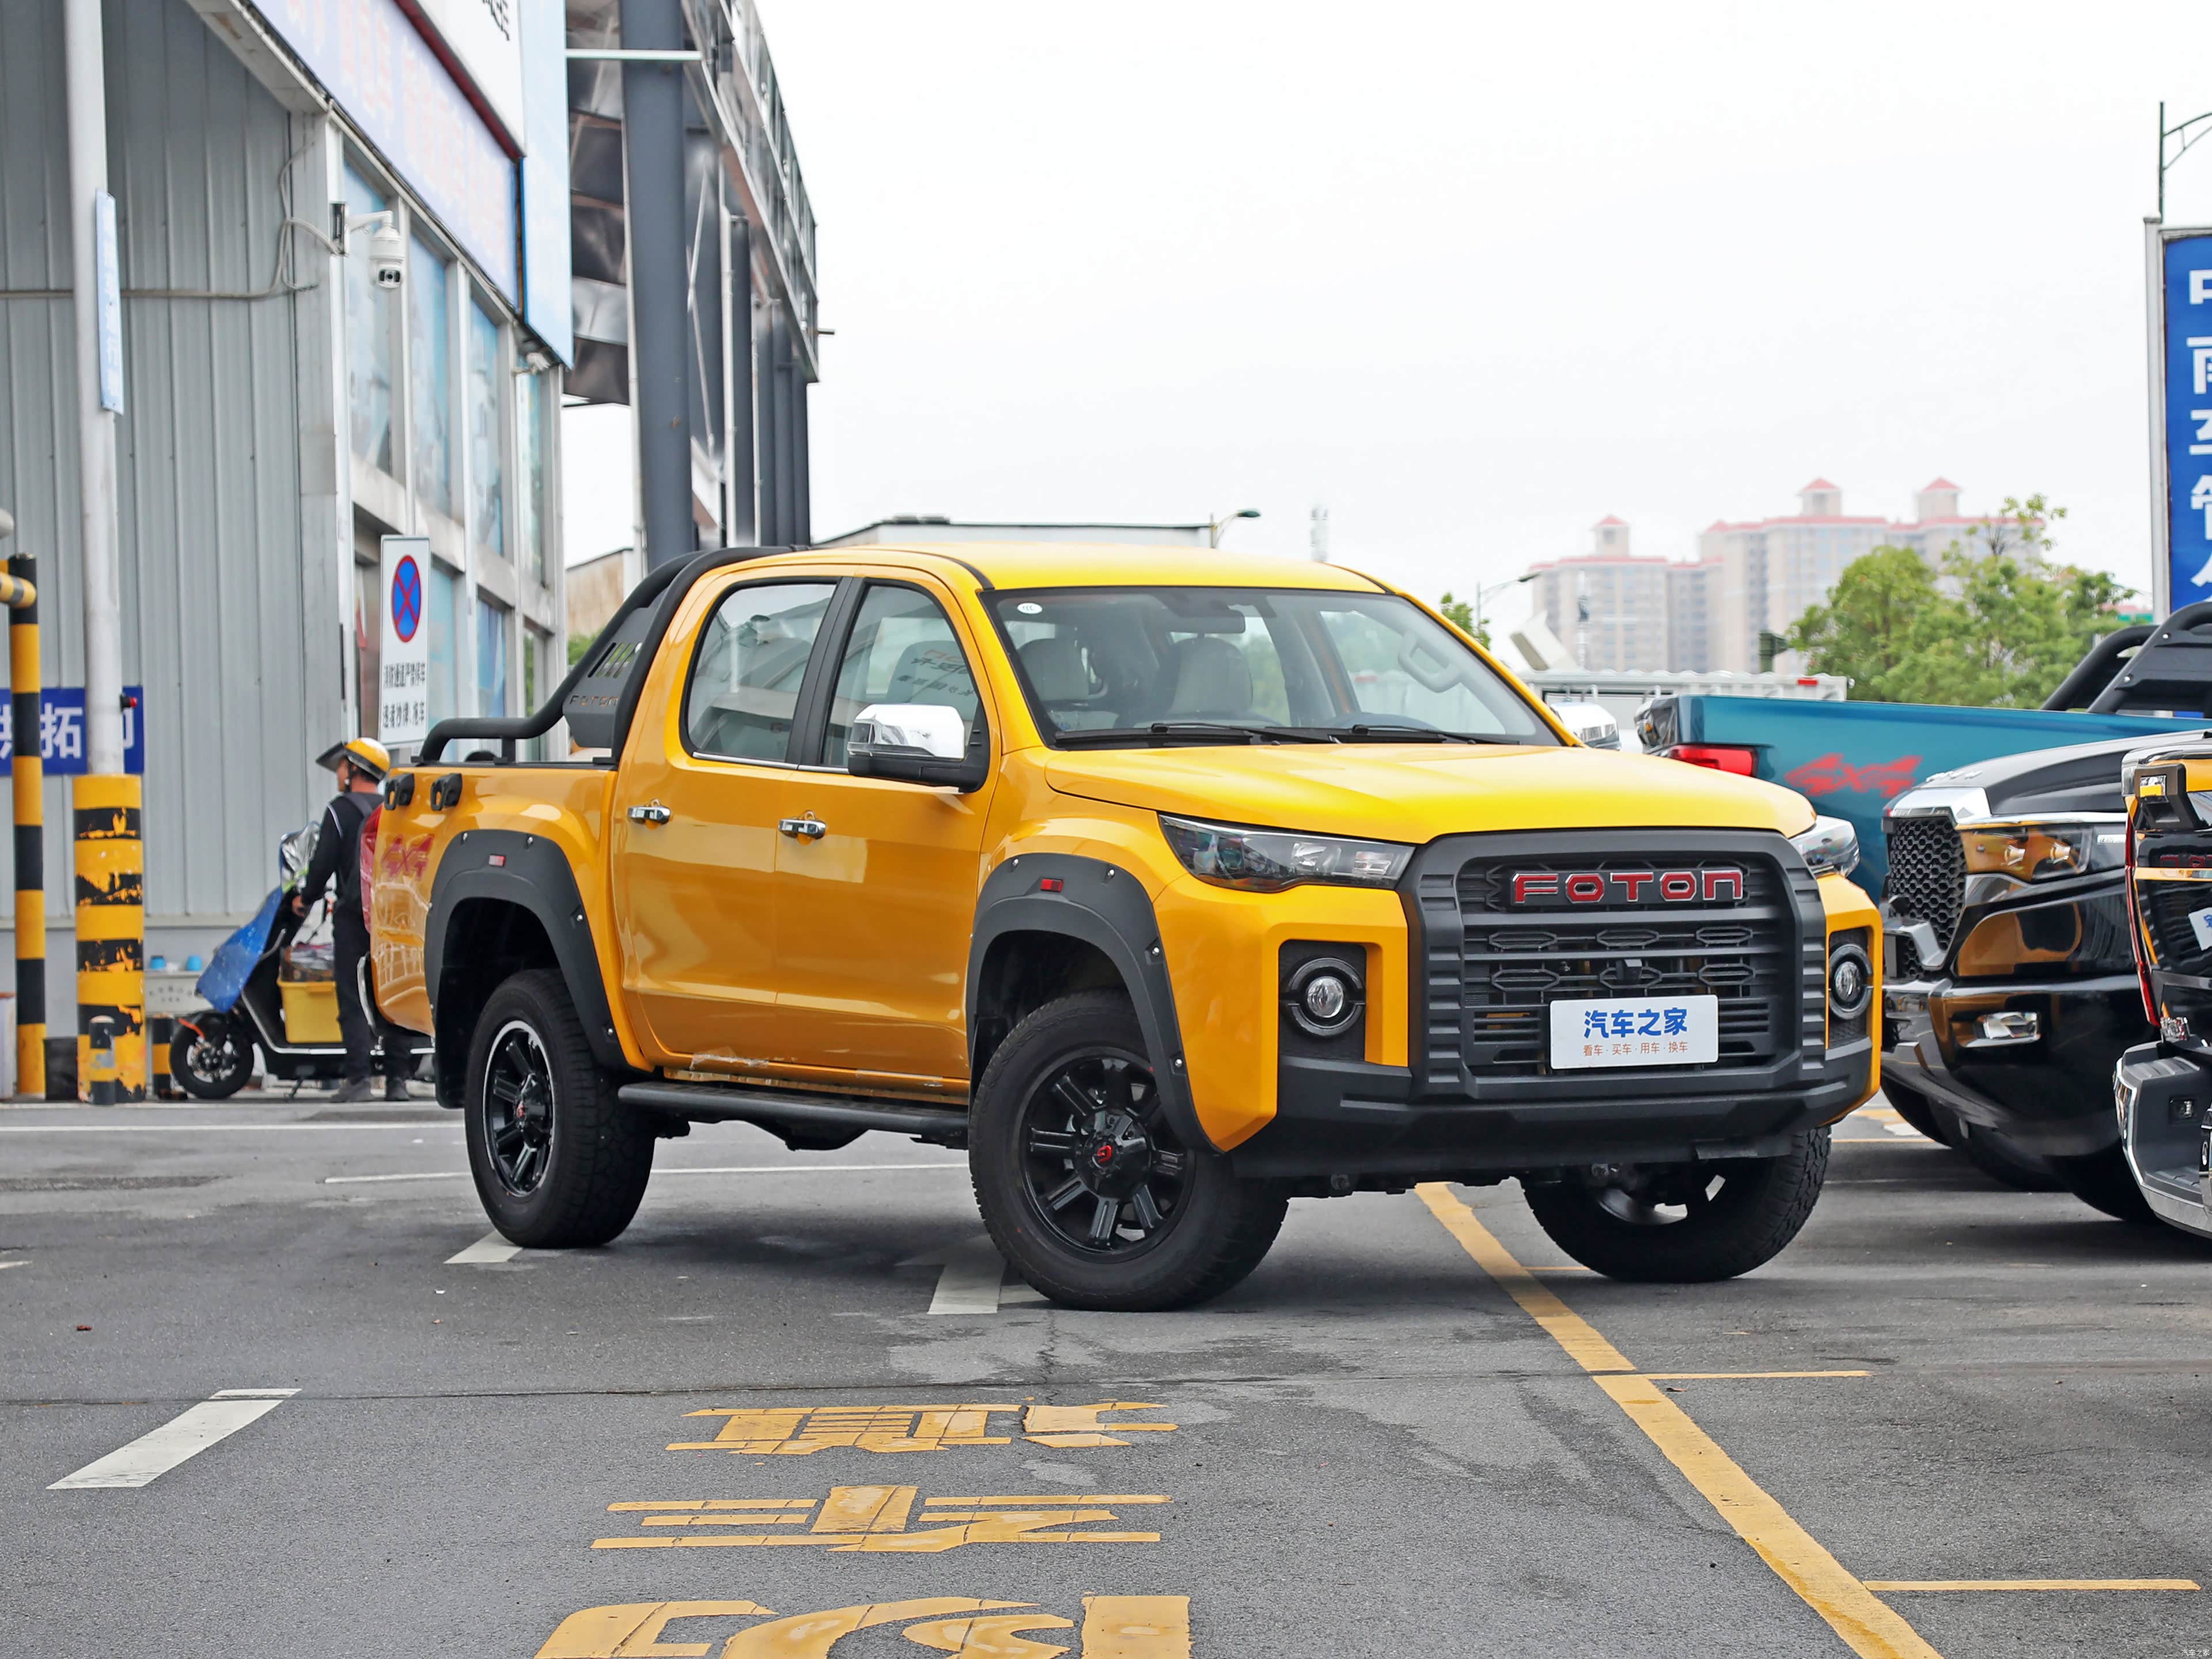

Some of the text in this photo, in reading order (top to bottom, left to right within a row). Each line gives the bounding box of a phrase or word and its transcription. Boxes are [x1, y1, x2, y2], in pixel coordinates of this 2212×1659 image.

[1512, 869, 1743, 903] FOTON
[1584, 1007, 1687, 1039] 汽车之家
